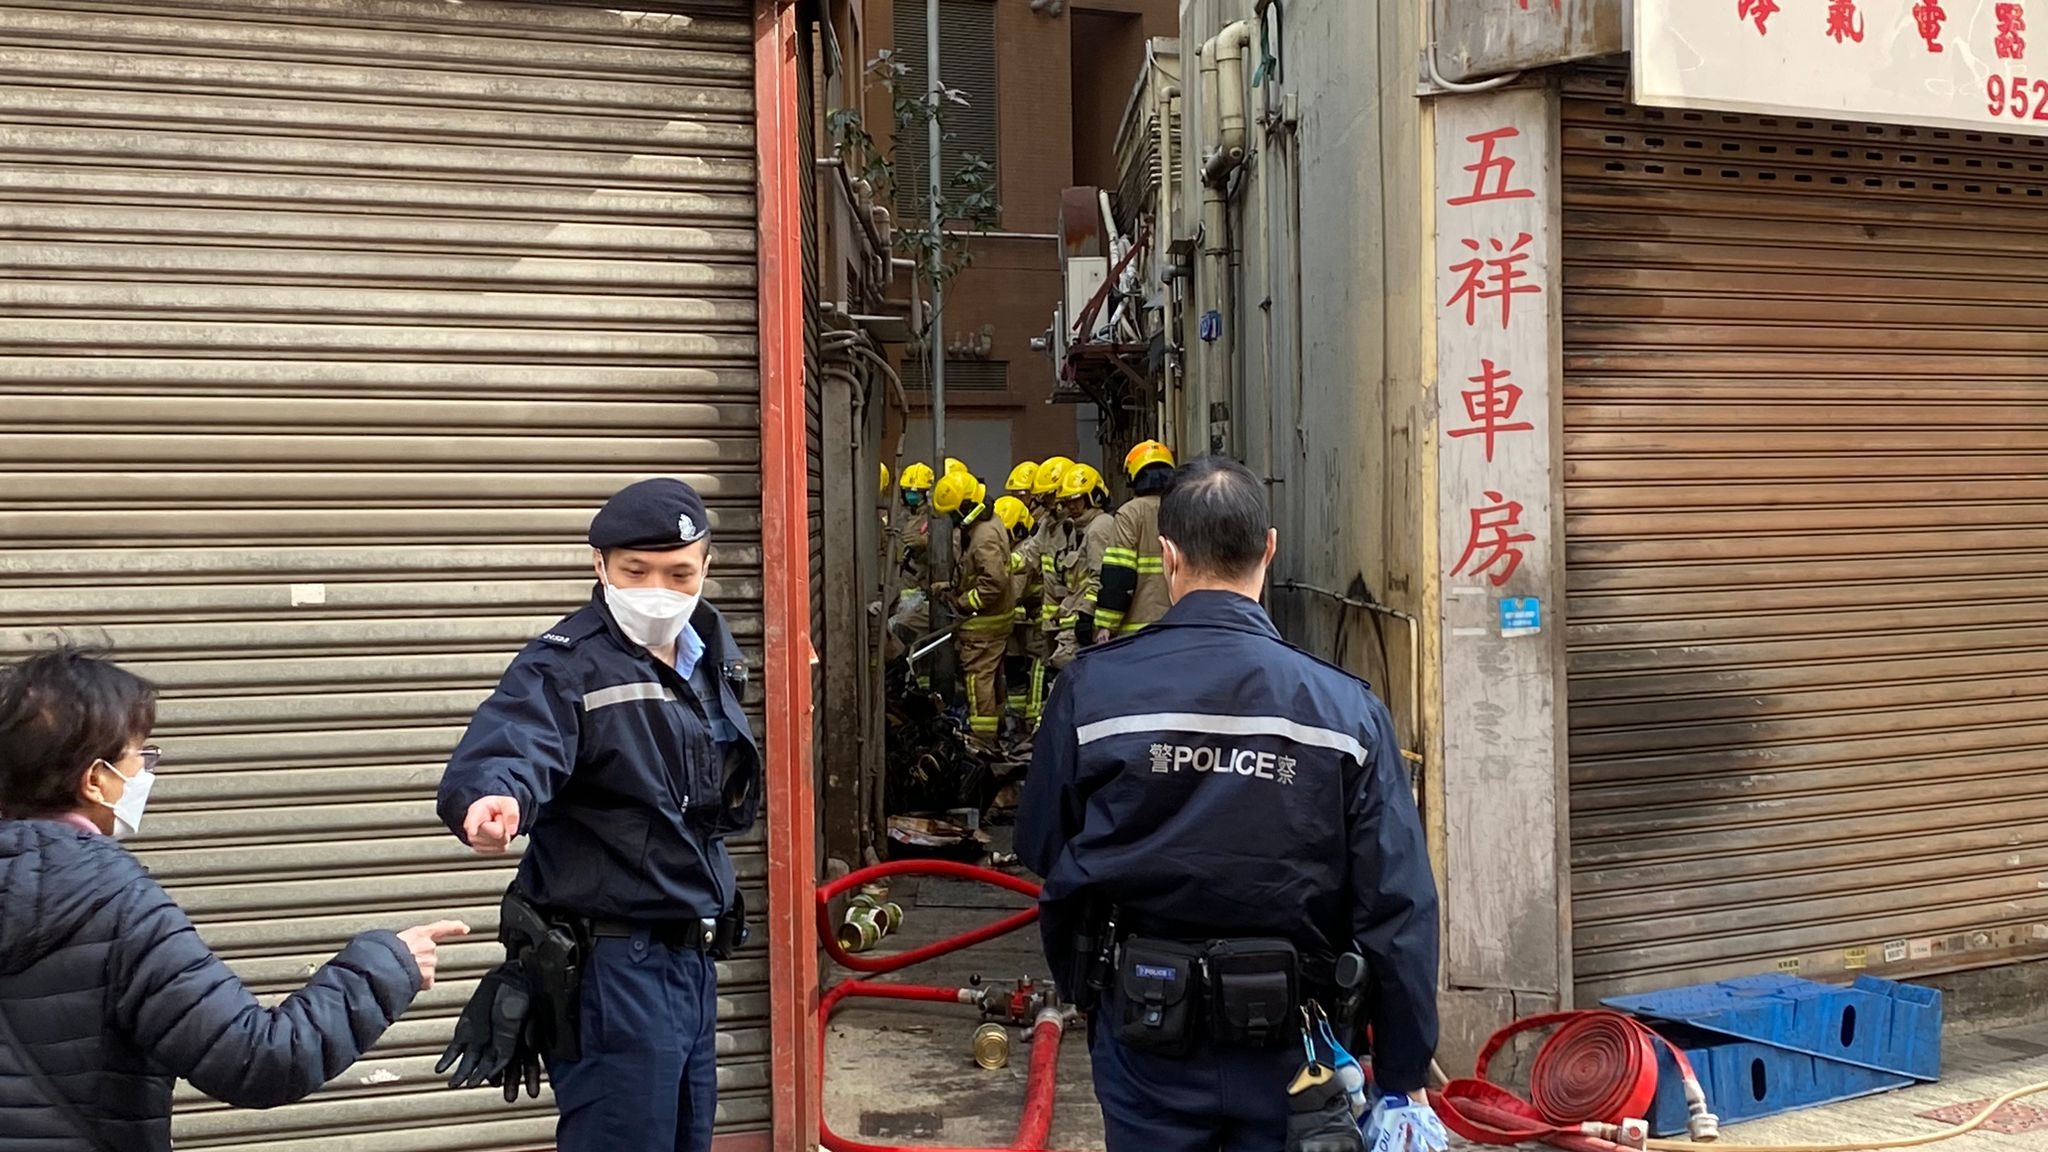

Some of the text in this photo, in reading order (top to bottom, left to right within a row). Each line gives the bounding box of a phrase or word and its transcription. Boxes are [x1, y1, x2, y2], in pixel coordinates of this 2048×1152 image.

[1986, 74, 2048, 121] 952
[1447, 126, 1542, 586] 五祥車房
